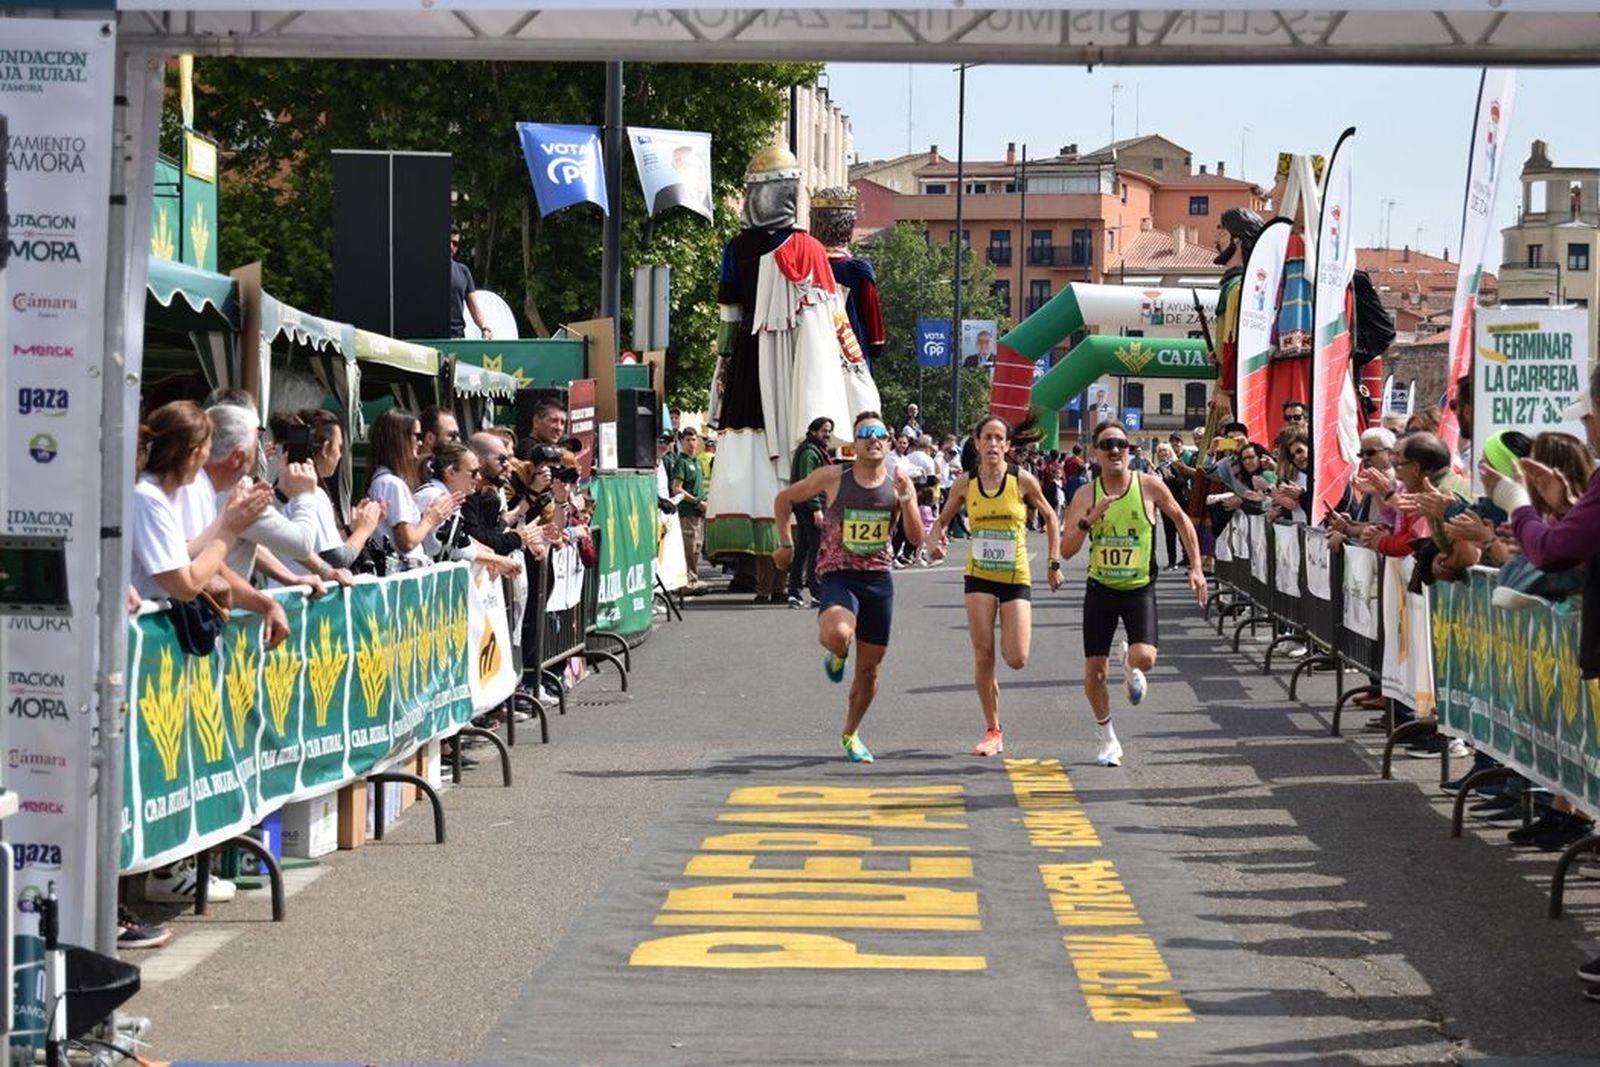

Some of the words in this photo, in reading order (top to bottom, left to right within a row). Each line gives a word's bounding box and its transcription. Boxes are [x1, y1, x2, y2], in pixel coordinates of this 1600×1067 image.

[0, 49, 88, 67] NDACION
[0, 66, 22, 81] JA
[29, 67, 88, 82] RURAL
[12, 292, 77, 312] Cámara
[1492, 331, 1573, 360] TERMINAR
[1157, 349, 1206, 367] CAJA
[1484, 365, 1504, 392] LA
[1506, 364, 1579, 392] CARRERA
[18, 387, 69, 416] gaza
[1492, 397, 1513, 424] EN
[849, 523, 882, 541] 124
[1100, 548, 1134, 566] 107
[12, 842, 62, 871] gaza
[628, 784, 989, 972] PIDEPAR
